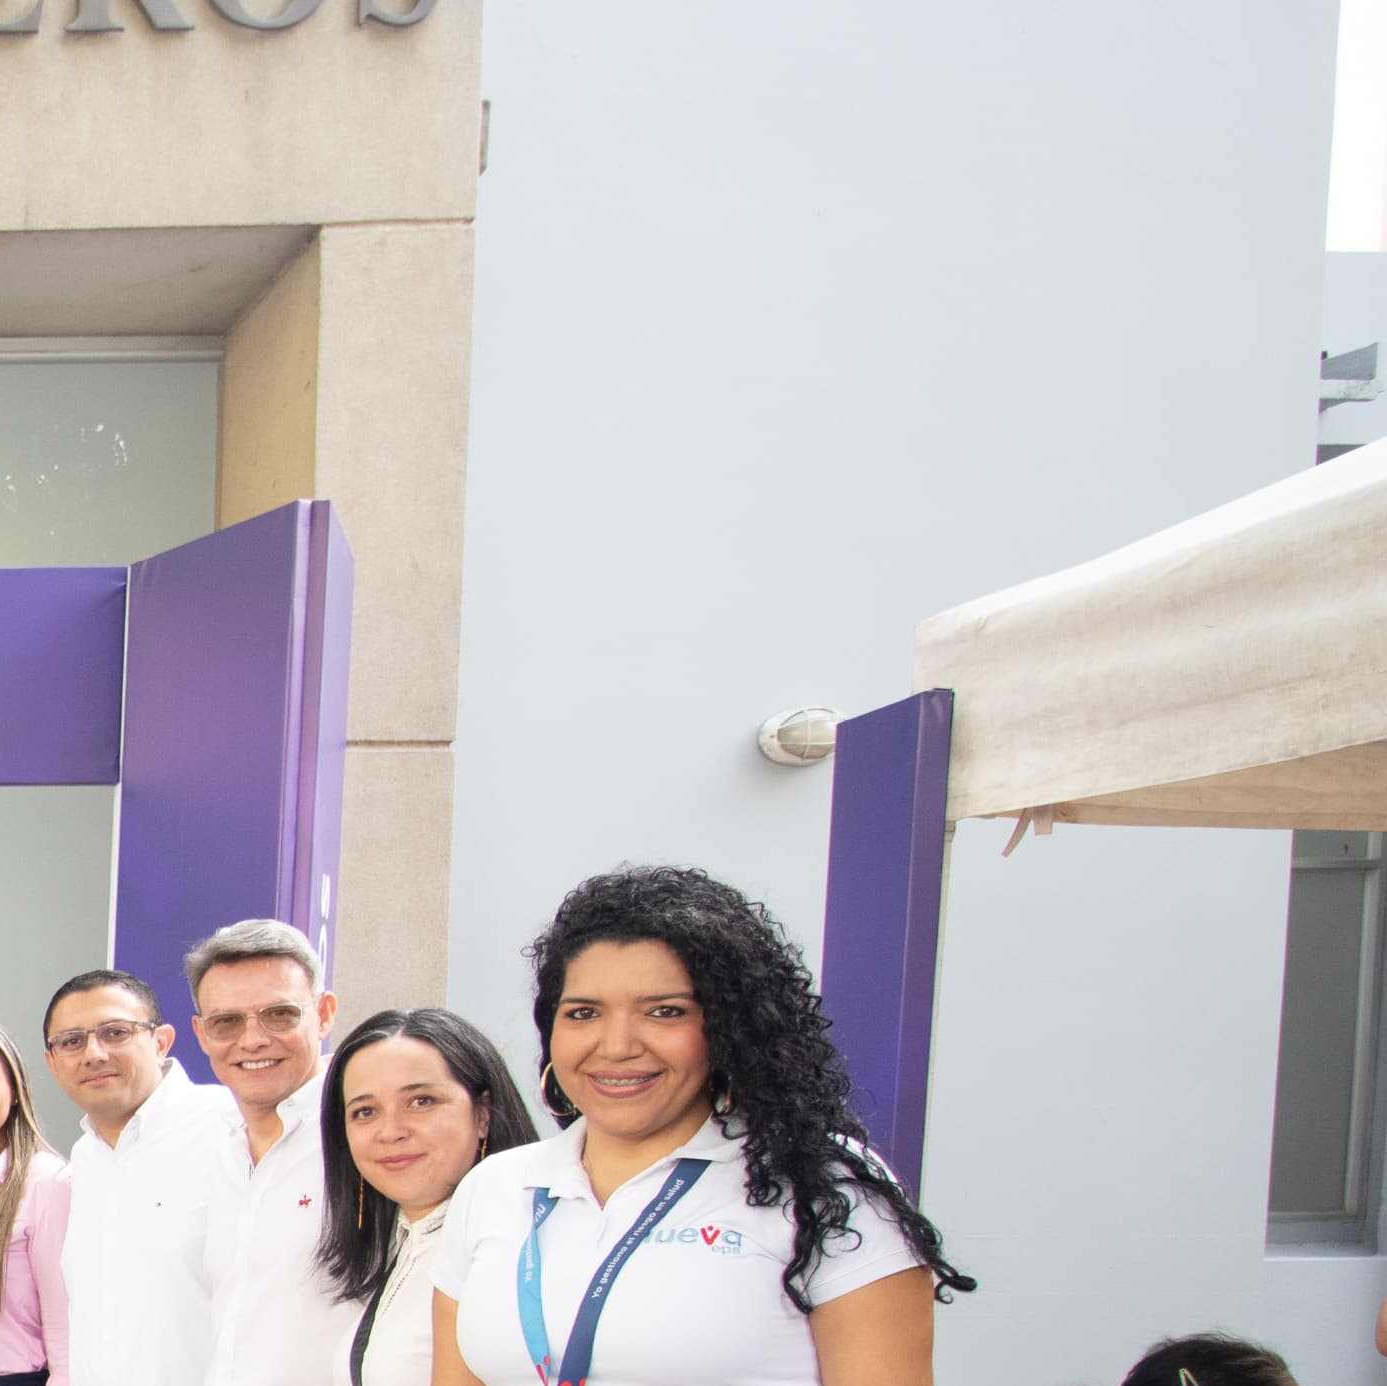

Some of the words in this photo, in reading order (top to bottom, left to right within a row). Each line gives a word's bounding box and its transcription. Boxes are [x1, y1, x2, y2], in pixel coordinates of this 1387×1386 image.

[591, 1286, 603, 1299] Yo
[655, 1201, 667, 1212] en
[664, 1179, 685, 1201] salud
[645, 1226, 742, 1247] ueva
